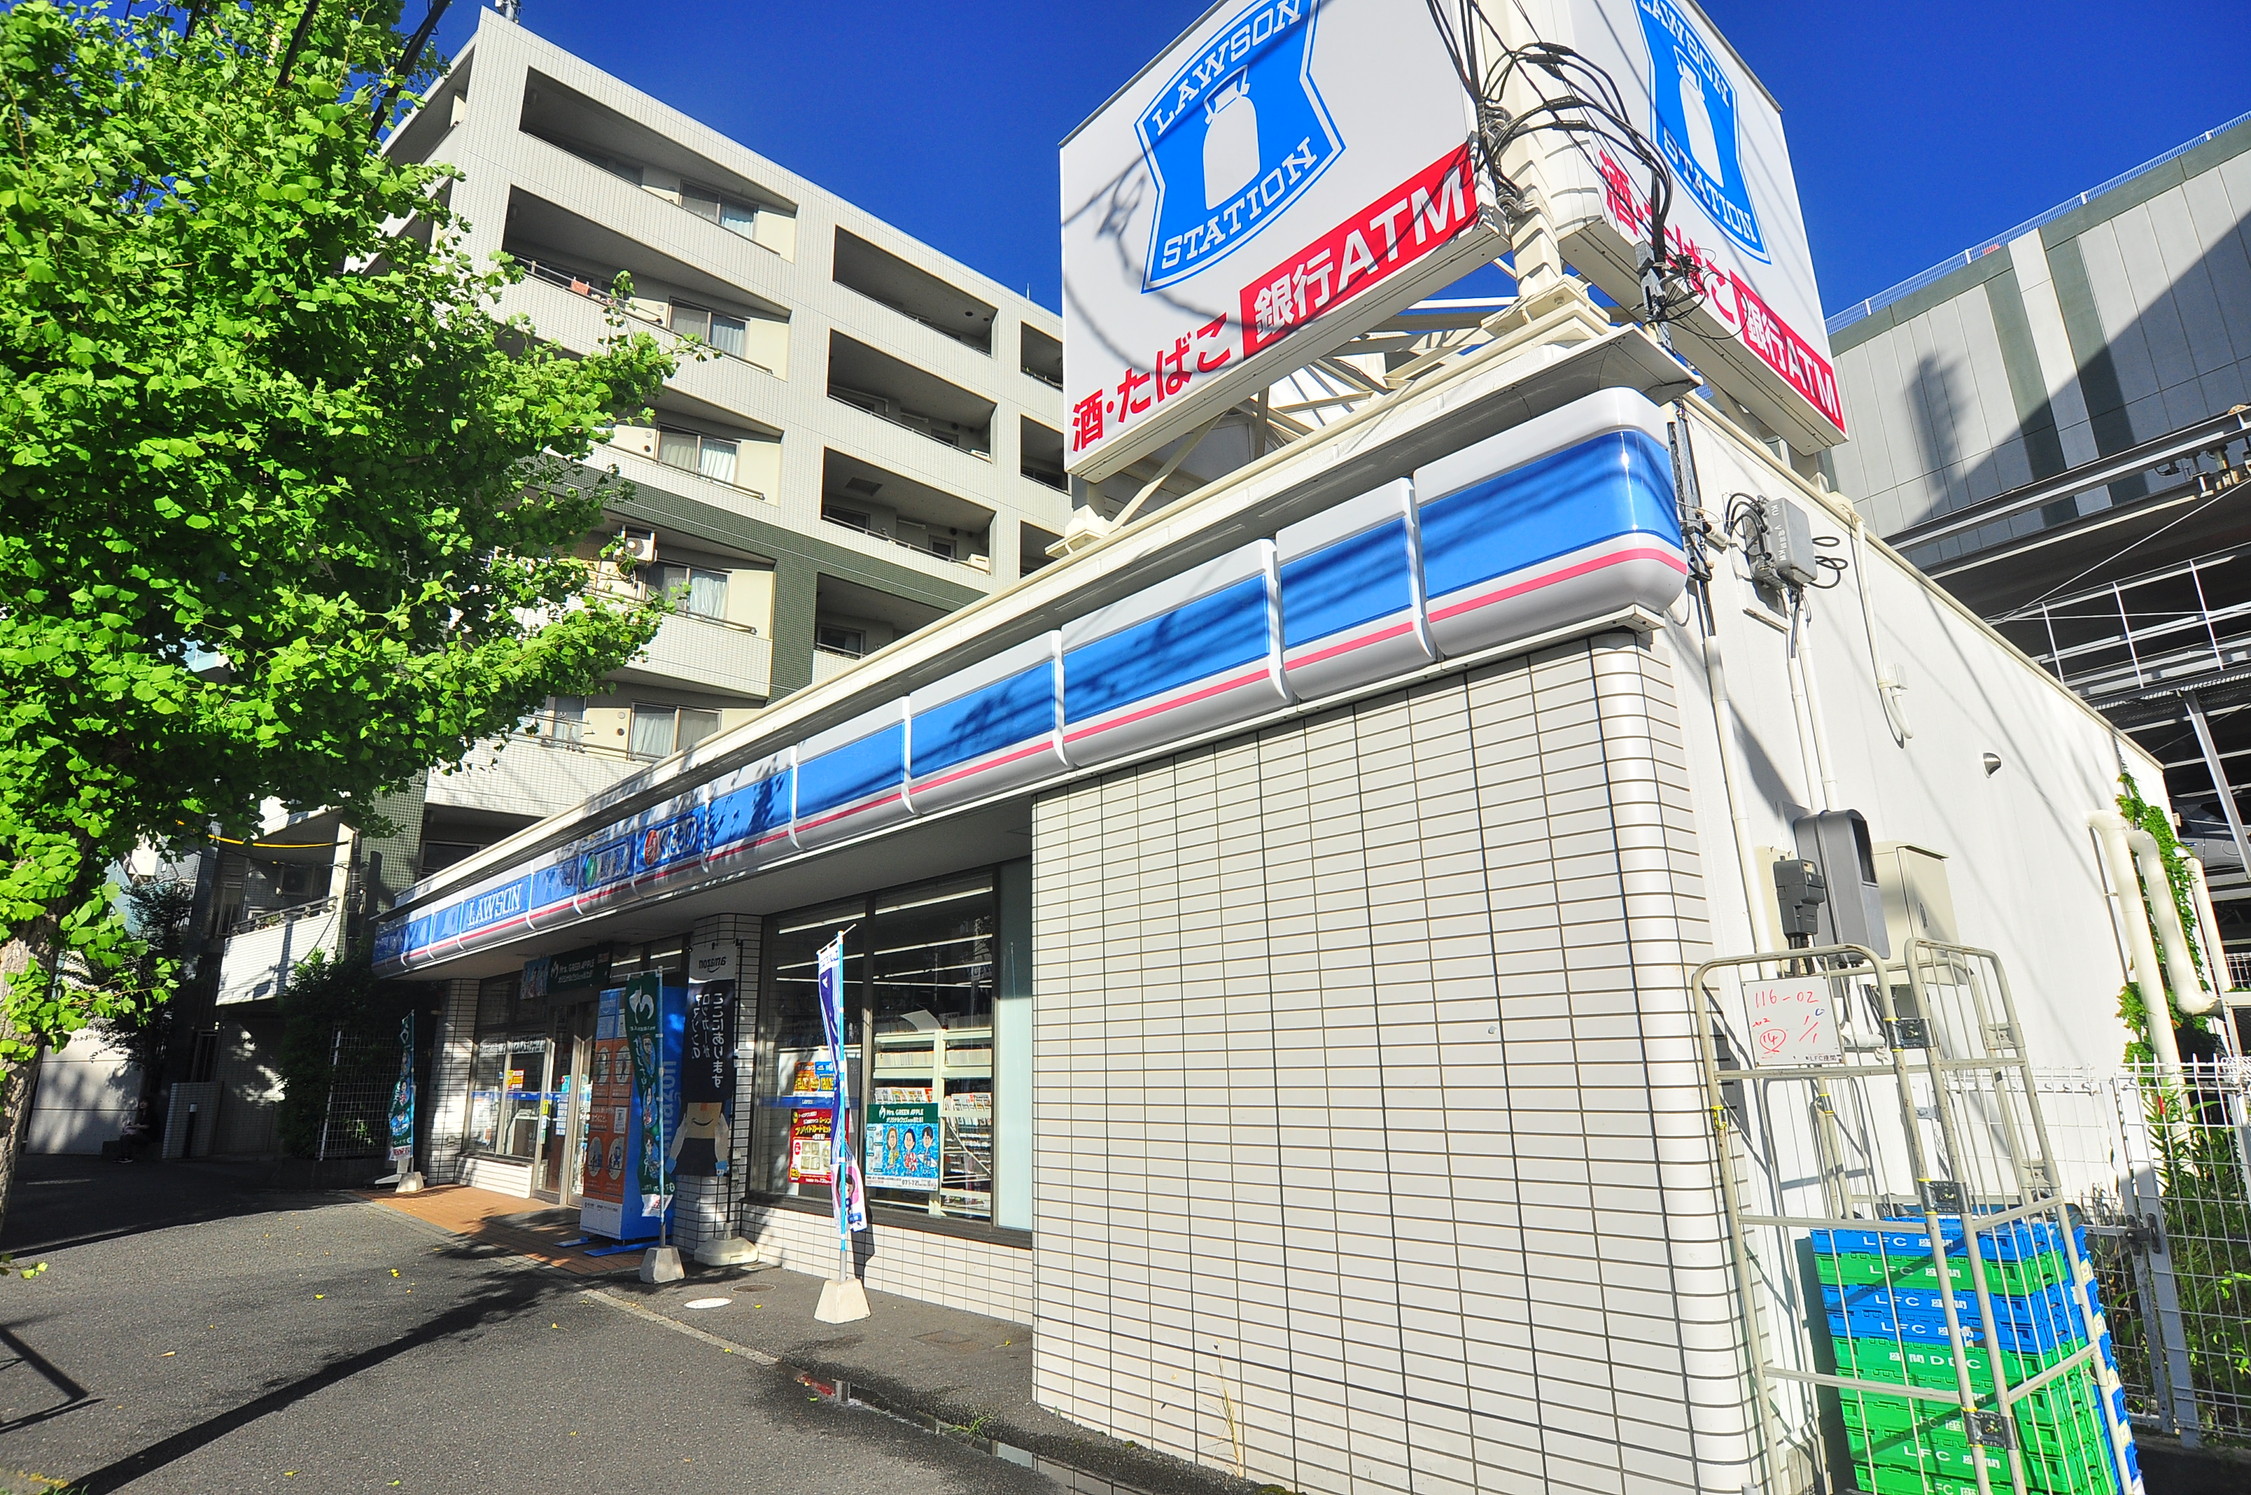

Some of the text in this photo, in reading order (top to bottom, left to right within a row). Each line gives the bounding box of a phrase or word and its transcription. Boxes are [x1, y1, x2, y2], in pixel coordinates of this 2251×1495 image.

[1152, 0, 1301, 136] LAWSON
[1162, 136, 1318, 271] STATION
[1663, 126, 1757, 244] STATION
[1253, 162, 1468, 342] 銀行ATM
[1071, 311, 1232, 453] 酒・たばこ
[1745, 306, 1842, 421] 銀行ATM
[468, 884, 521, 928] LAWSON
[1903, 1445, 1951, 1462] LFC
